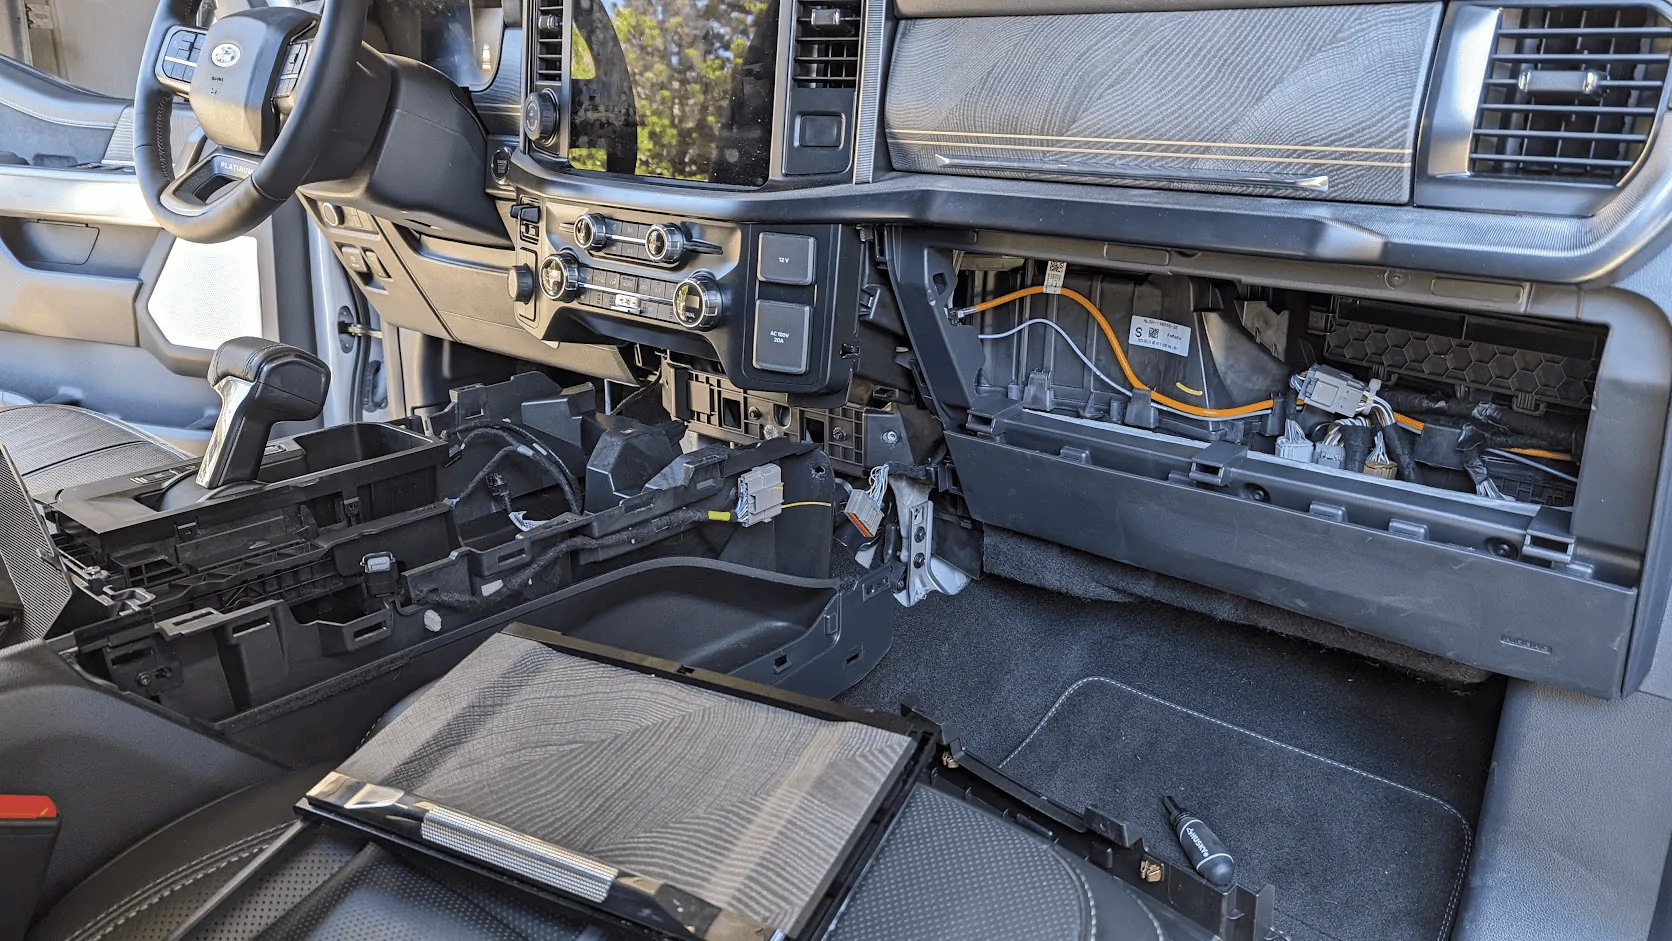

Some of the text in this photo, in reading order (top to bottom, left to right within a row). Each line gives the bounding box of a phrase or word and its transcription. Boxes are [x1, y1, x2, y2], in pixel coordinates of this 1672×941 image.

[220, 161, 254, 175] PLATINUM
[777, 331, 790, 339] 120V
[1135, 327, 1143, 337] S
[1189, 832, 1209, 854] HUSKY
